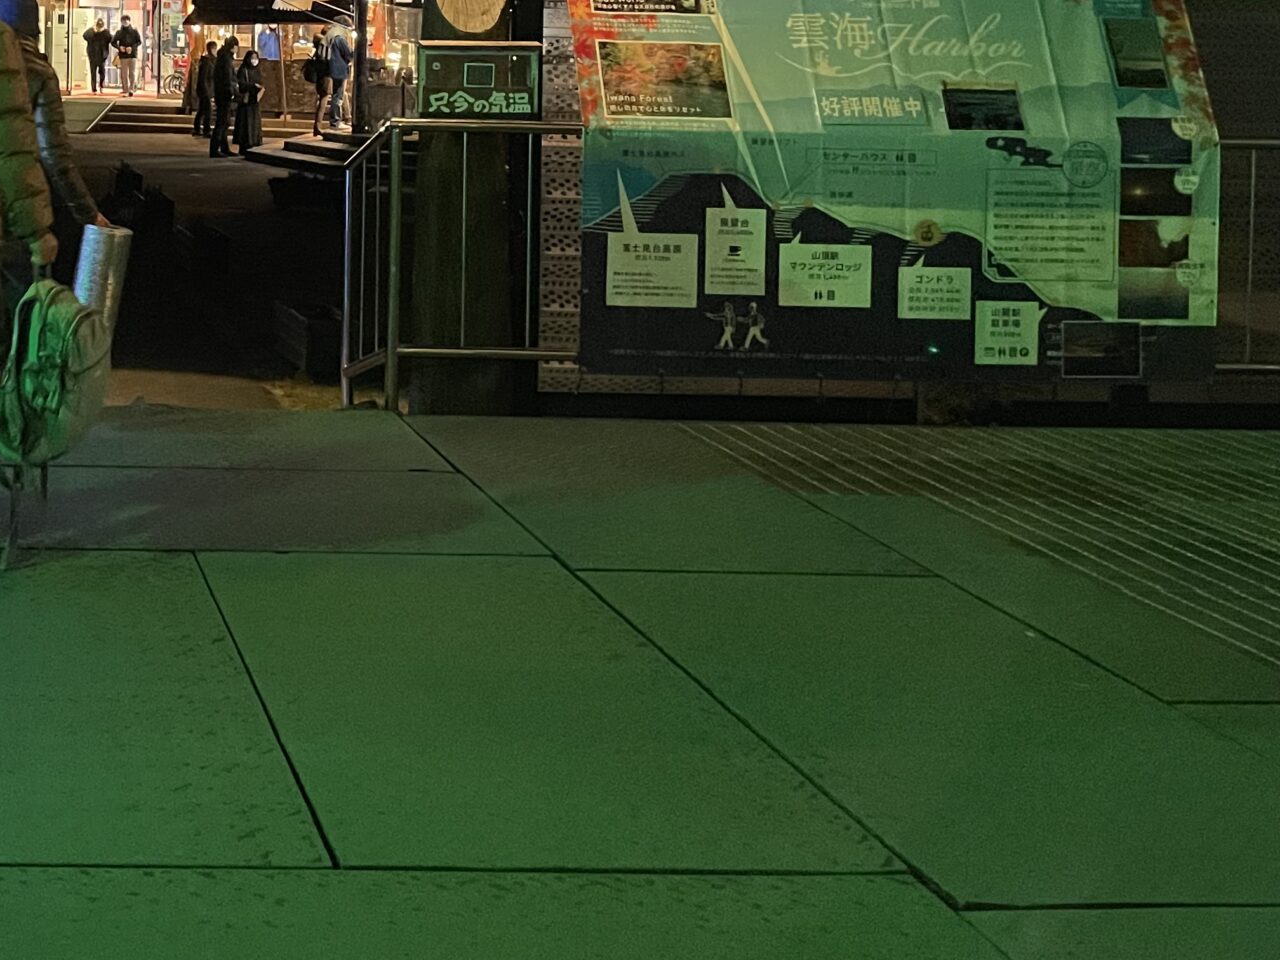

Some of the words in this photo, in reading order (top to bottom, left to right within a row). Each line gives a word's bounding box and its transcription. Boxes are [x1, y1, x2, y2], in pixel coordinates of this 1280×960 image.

[785, 12, 876, 51] 雲海
[854, 13, 1027, 59] Harbor
[428, 90, 532, 114] 只今の気温
[821, 96, 922, 119] 好評開催中
[823, 152, 888, 161] センターハウス
[789, 262, 863, 272] マウンテンロッジ
[915, 274, 954, 285] ゴンドラ
